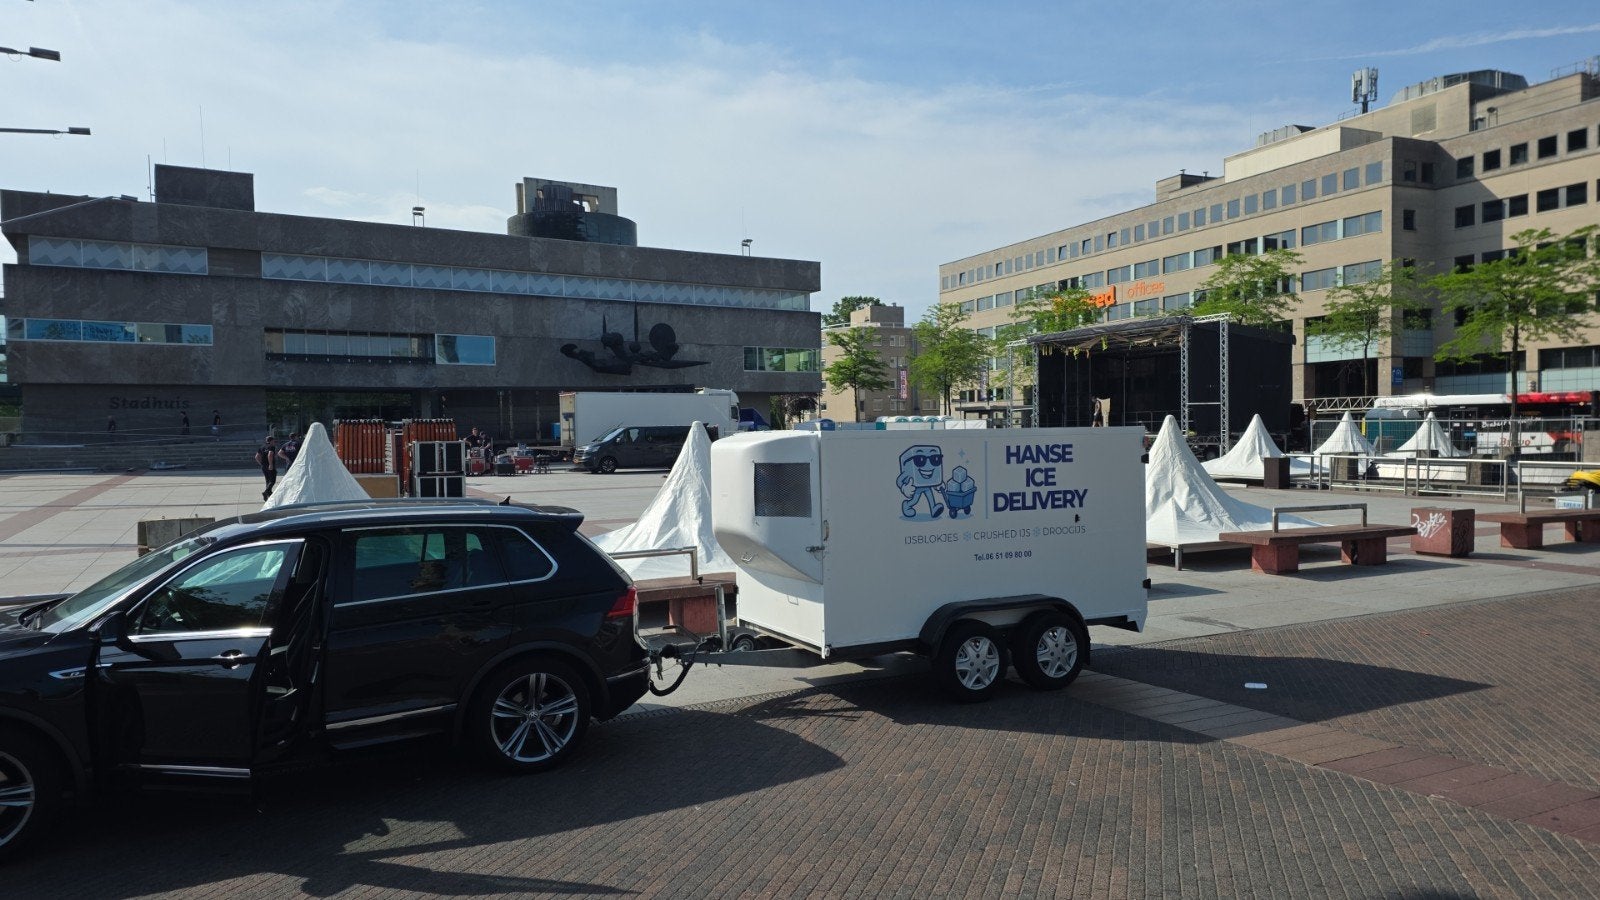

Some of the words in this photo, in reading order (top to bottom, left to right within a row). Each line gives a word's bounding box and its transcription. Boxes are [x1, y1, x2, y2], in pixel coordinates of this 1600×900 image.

[1128, 281, 1165, 298] offices
[109, 396, 190, 409] Stadhuis
[1005, 444, 1074, 464] HANSE
[1025, 467, 1057, 487] ICE
[993, 489, 1088, 512] DELIVERY
[904, 532, 959, 545] IJSBLOKJES
[973, 529, 1018, 541] CRUSHED
[1019, 528, 1031, 538] IJS
[1042, 525, 1086, 536] DROOGIJS
[995, 552, 1003, 560] 51
